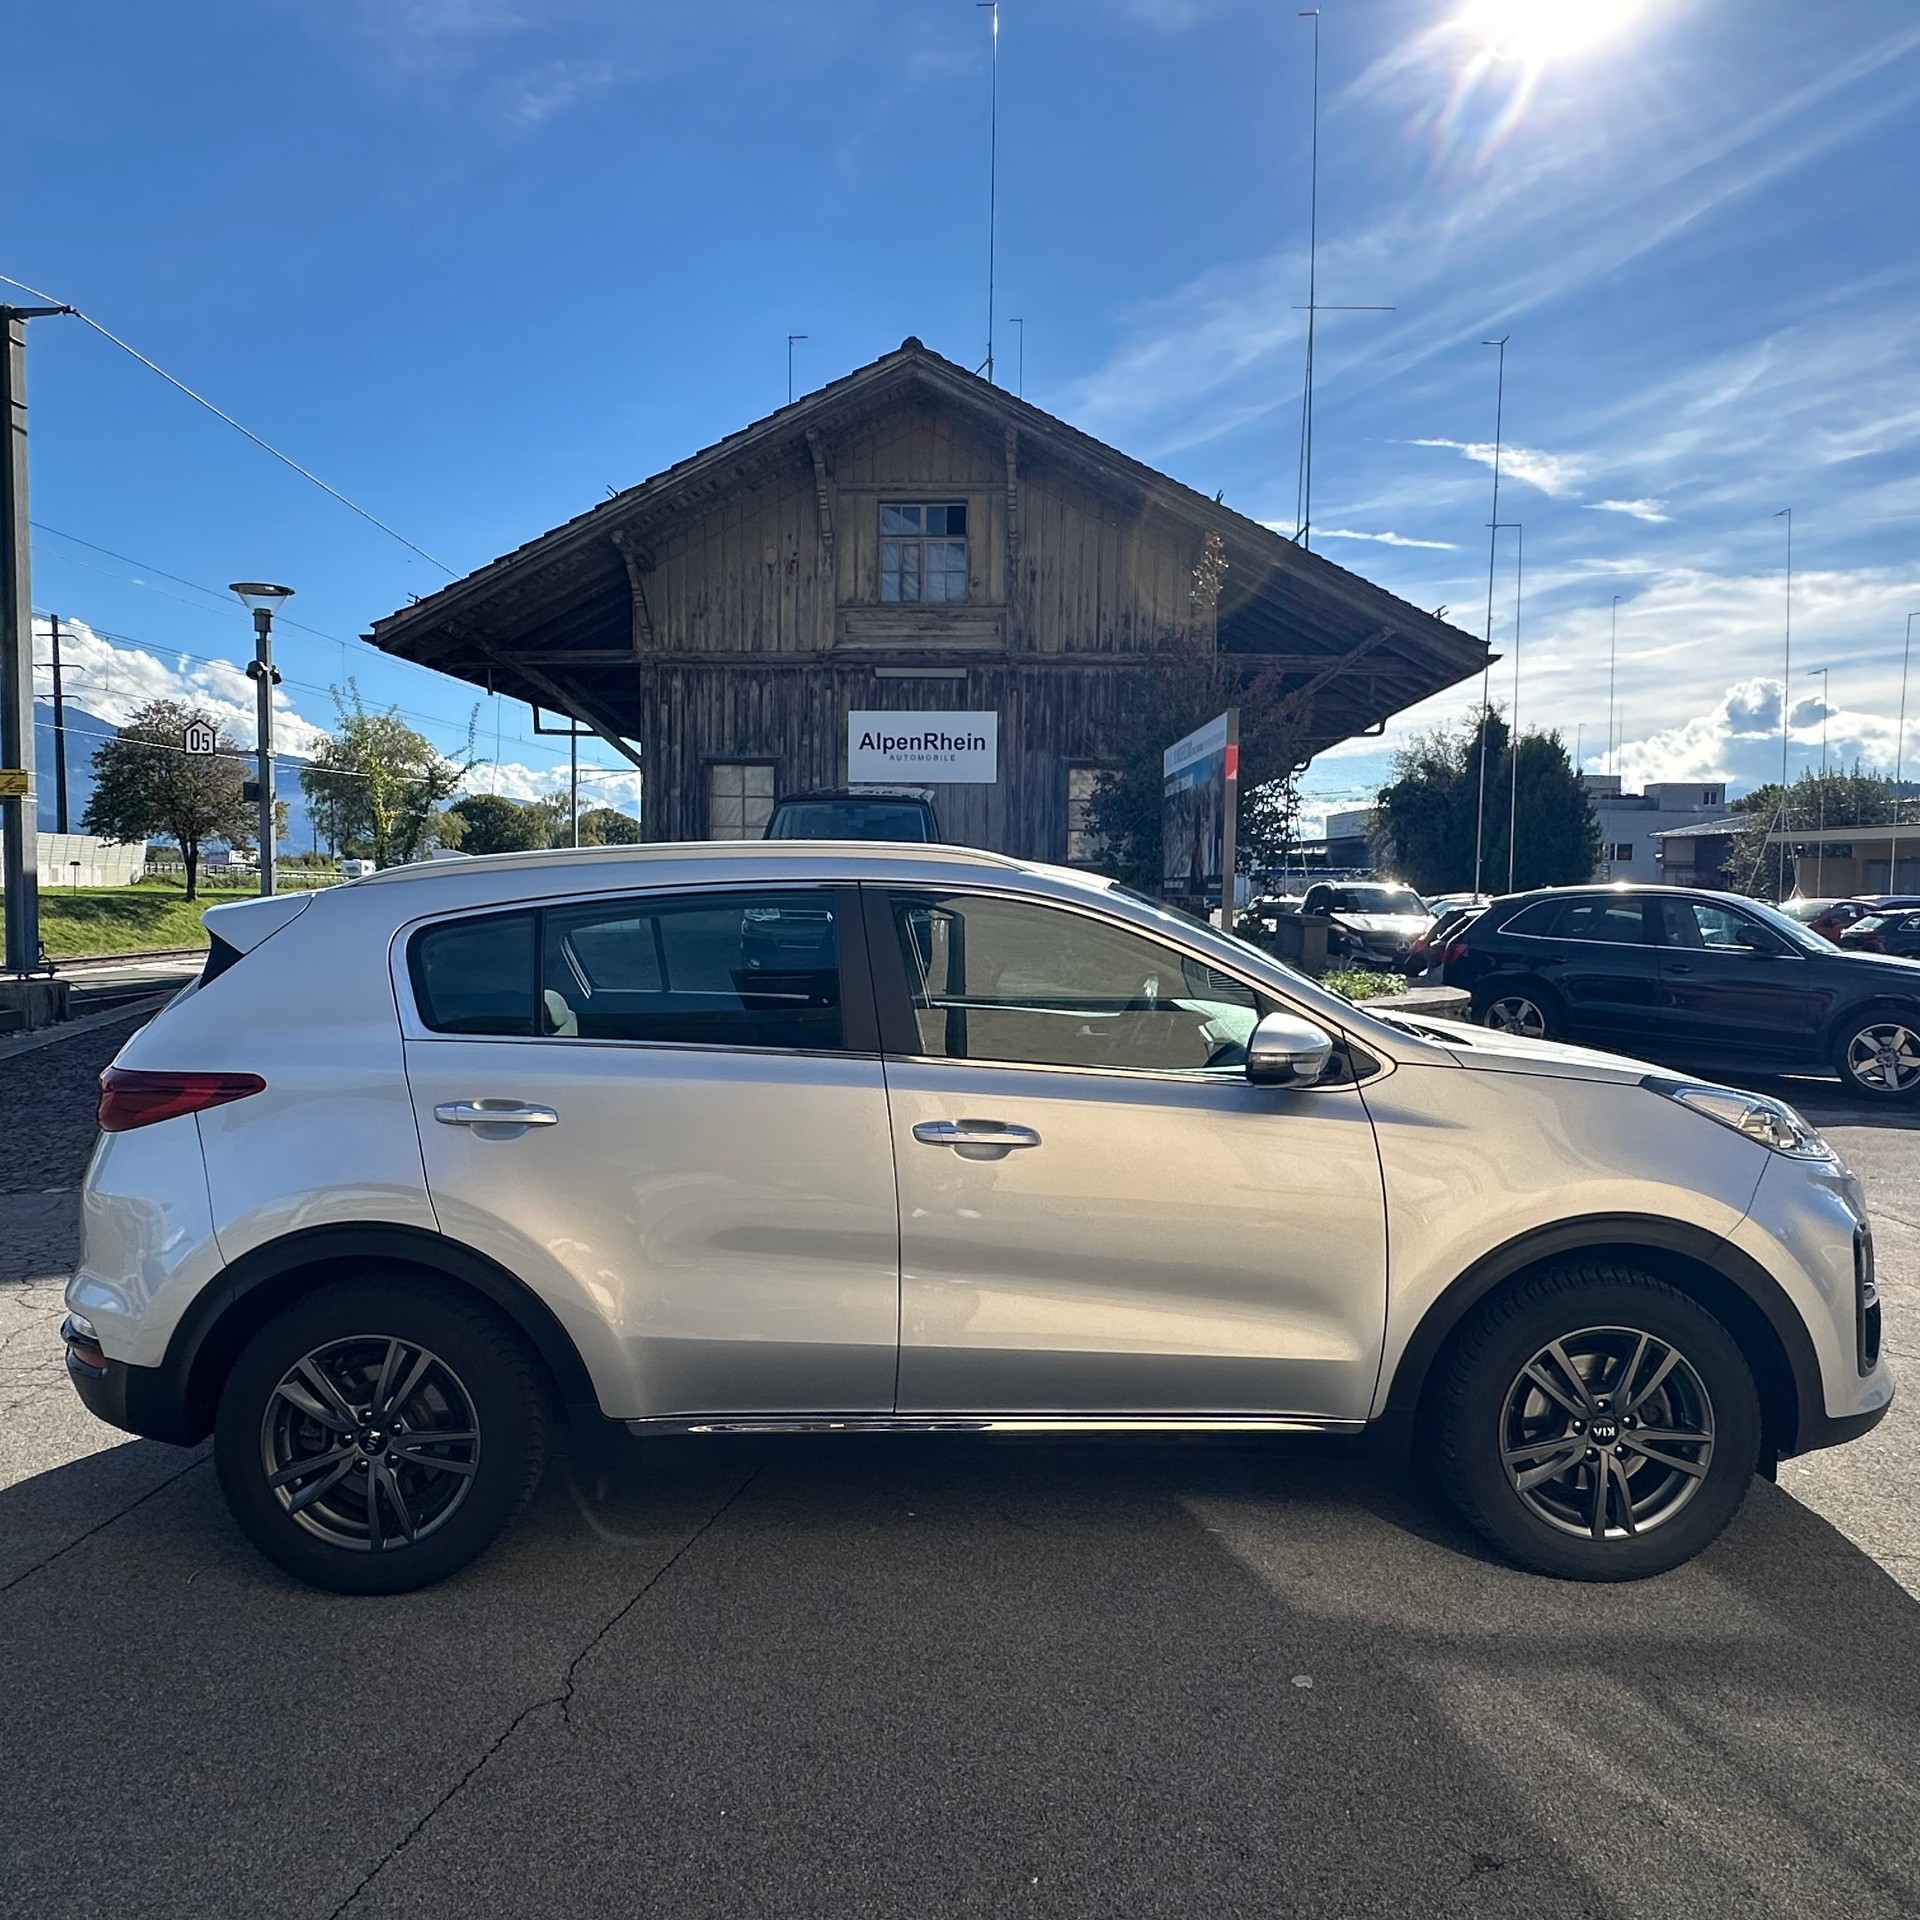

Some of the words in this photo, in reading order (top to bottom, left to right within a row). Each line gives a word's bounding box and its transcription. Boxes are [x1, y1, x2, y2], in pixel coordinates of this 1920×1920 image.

[190, 728, 210, 752] 05
[859, 732, 986, 755] AlpenRhein
[889, 754, 956, 762] AUTOMOBILE
[1593, 1426, 1616, 1438] KIA
